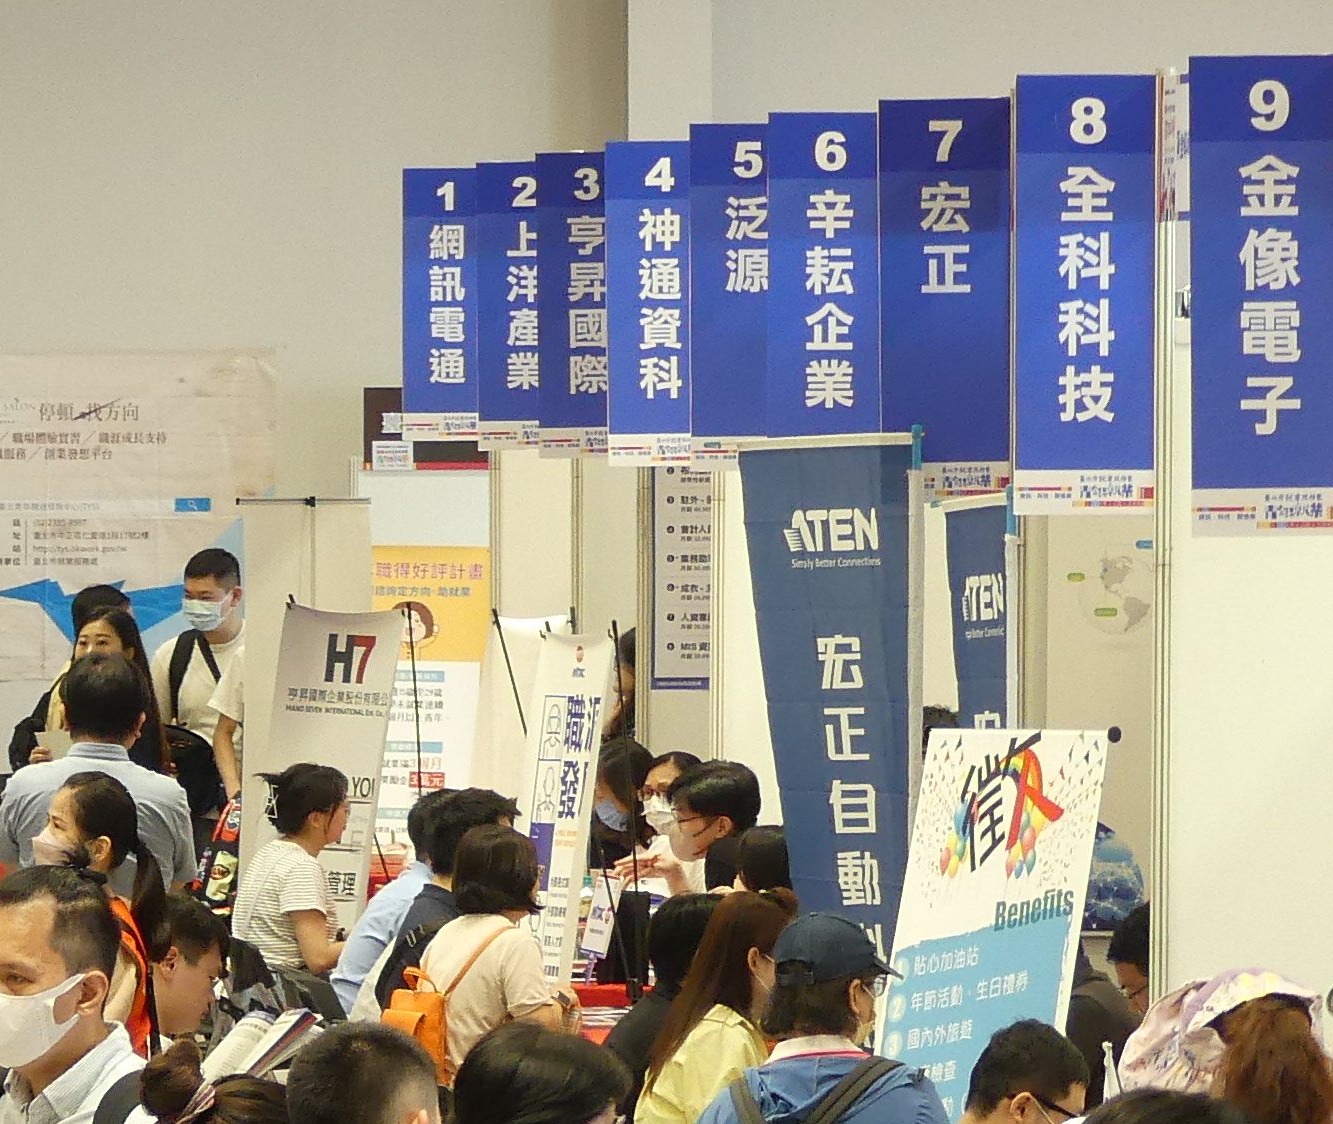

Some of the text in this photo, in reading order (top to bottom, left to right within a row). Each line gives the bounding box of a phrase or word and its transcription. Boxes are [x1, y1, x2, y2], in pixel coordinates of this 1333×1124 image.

[1070, 98, 1106, 144] 8
[1249, 80, 1289, 131] 9
[734, 142, 762, 178] 5
[815, 131, 846, 171] 6
[929, 121, 962, 161] 7
[437, 182, 454, 210] 1
[512, 177, 536, 206] 2
[575, 168, 599, 200] 3
[645, 157, 674, 192] 4
[726, 197, 768, 292] 泛源
[921, 182, 970, 293] 宏正
[429, 225, 465, 383] 網訊電通
[507, 221, 538, 389] 上洋產業
[639, 208, 682, 399] 神通資科
[805, 190, 854, 408] 辛耘企業
[1058, 167, 1115, 422] 全科科技
[1239, 155, 1301, 435] 金像電子
[783, 508, 879, 552] ATEN
[837, 556, 881, 568] Connections
[324, 633, 376, 685] H7
[994, 889, 1074, 931] Benefits
[914, 945, 979, 977] 貼心加油站
[907, 1020, 973, 1050] 國內外旅遊
